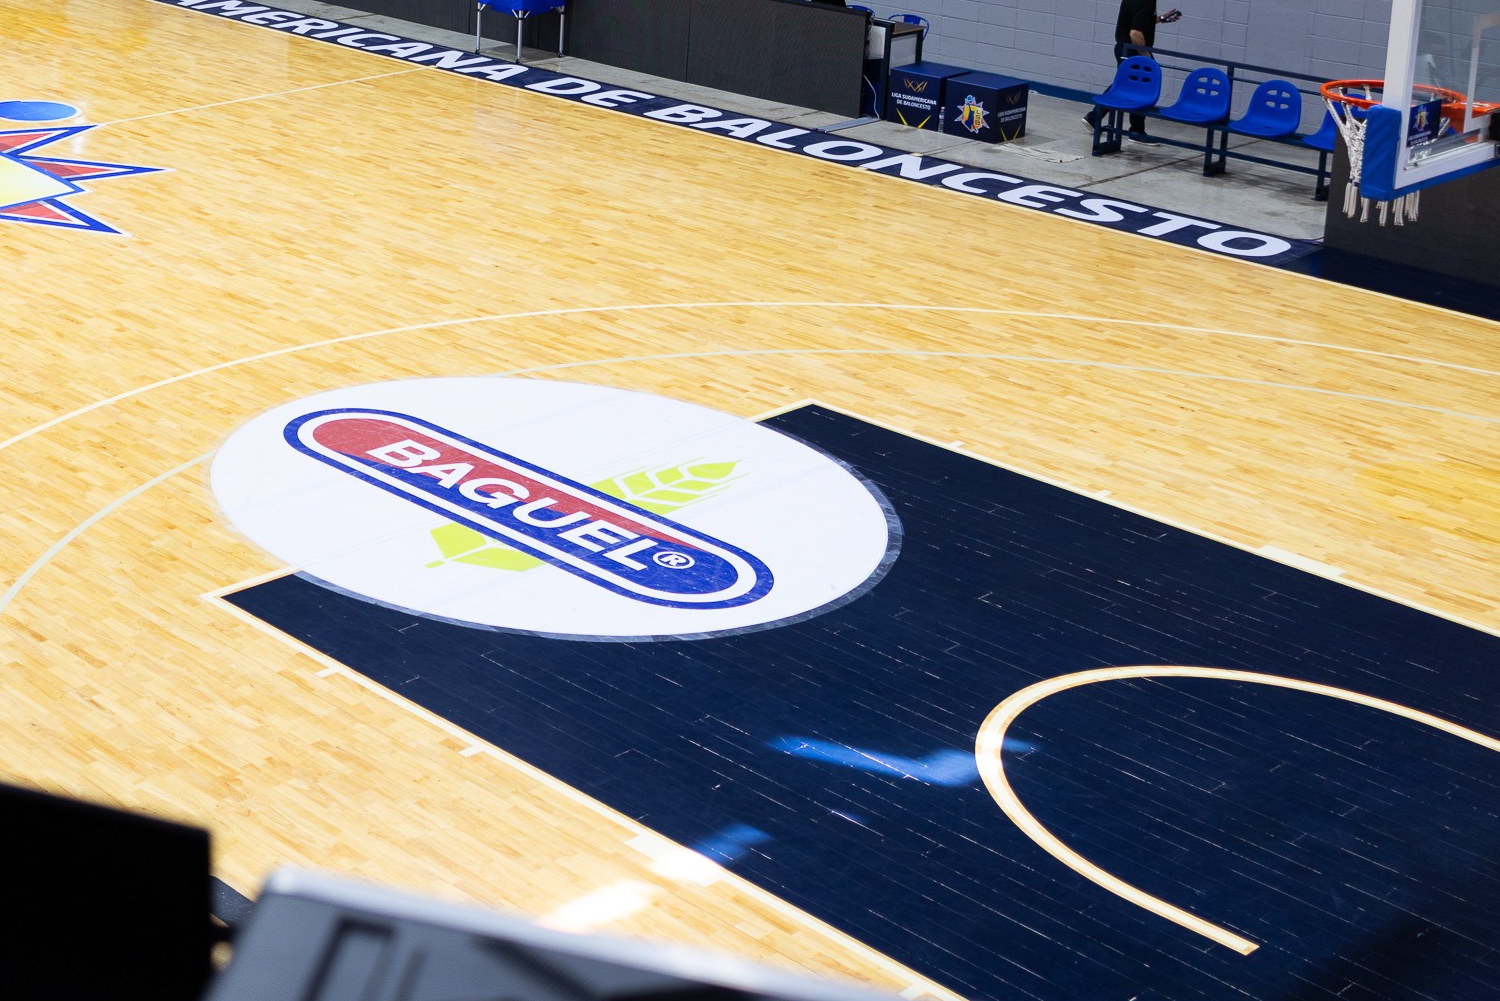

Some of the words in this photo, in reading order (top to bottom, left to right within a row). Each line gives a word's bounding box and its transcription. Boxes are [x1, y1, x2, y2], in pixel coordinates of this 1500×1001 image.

[902, 93, 937, 106] SUDAMERICANA
[903, 100, 931, 111] BALONCESTO
[524, 77, 655, 107] DE
[643, 103, 1292, 258] BALONCESTO
